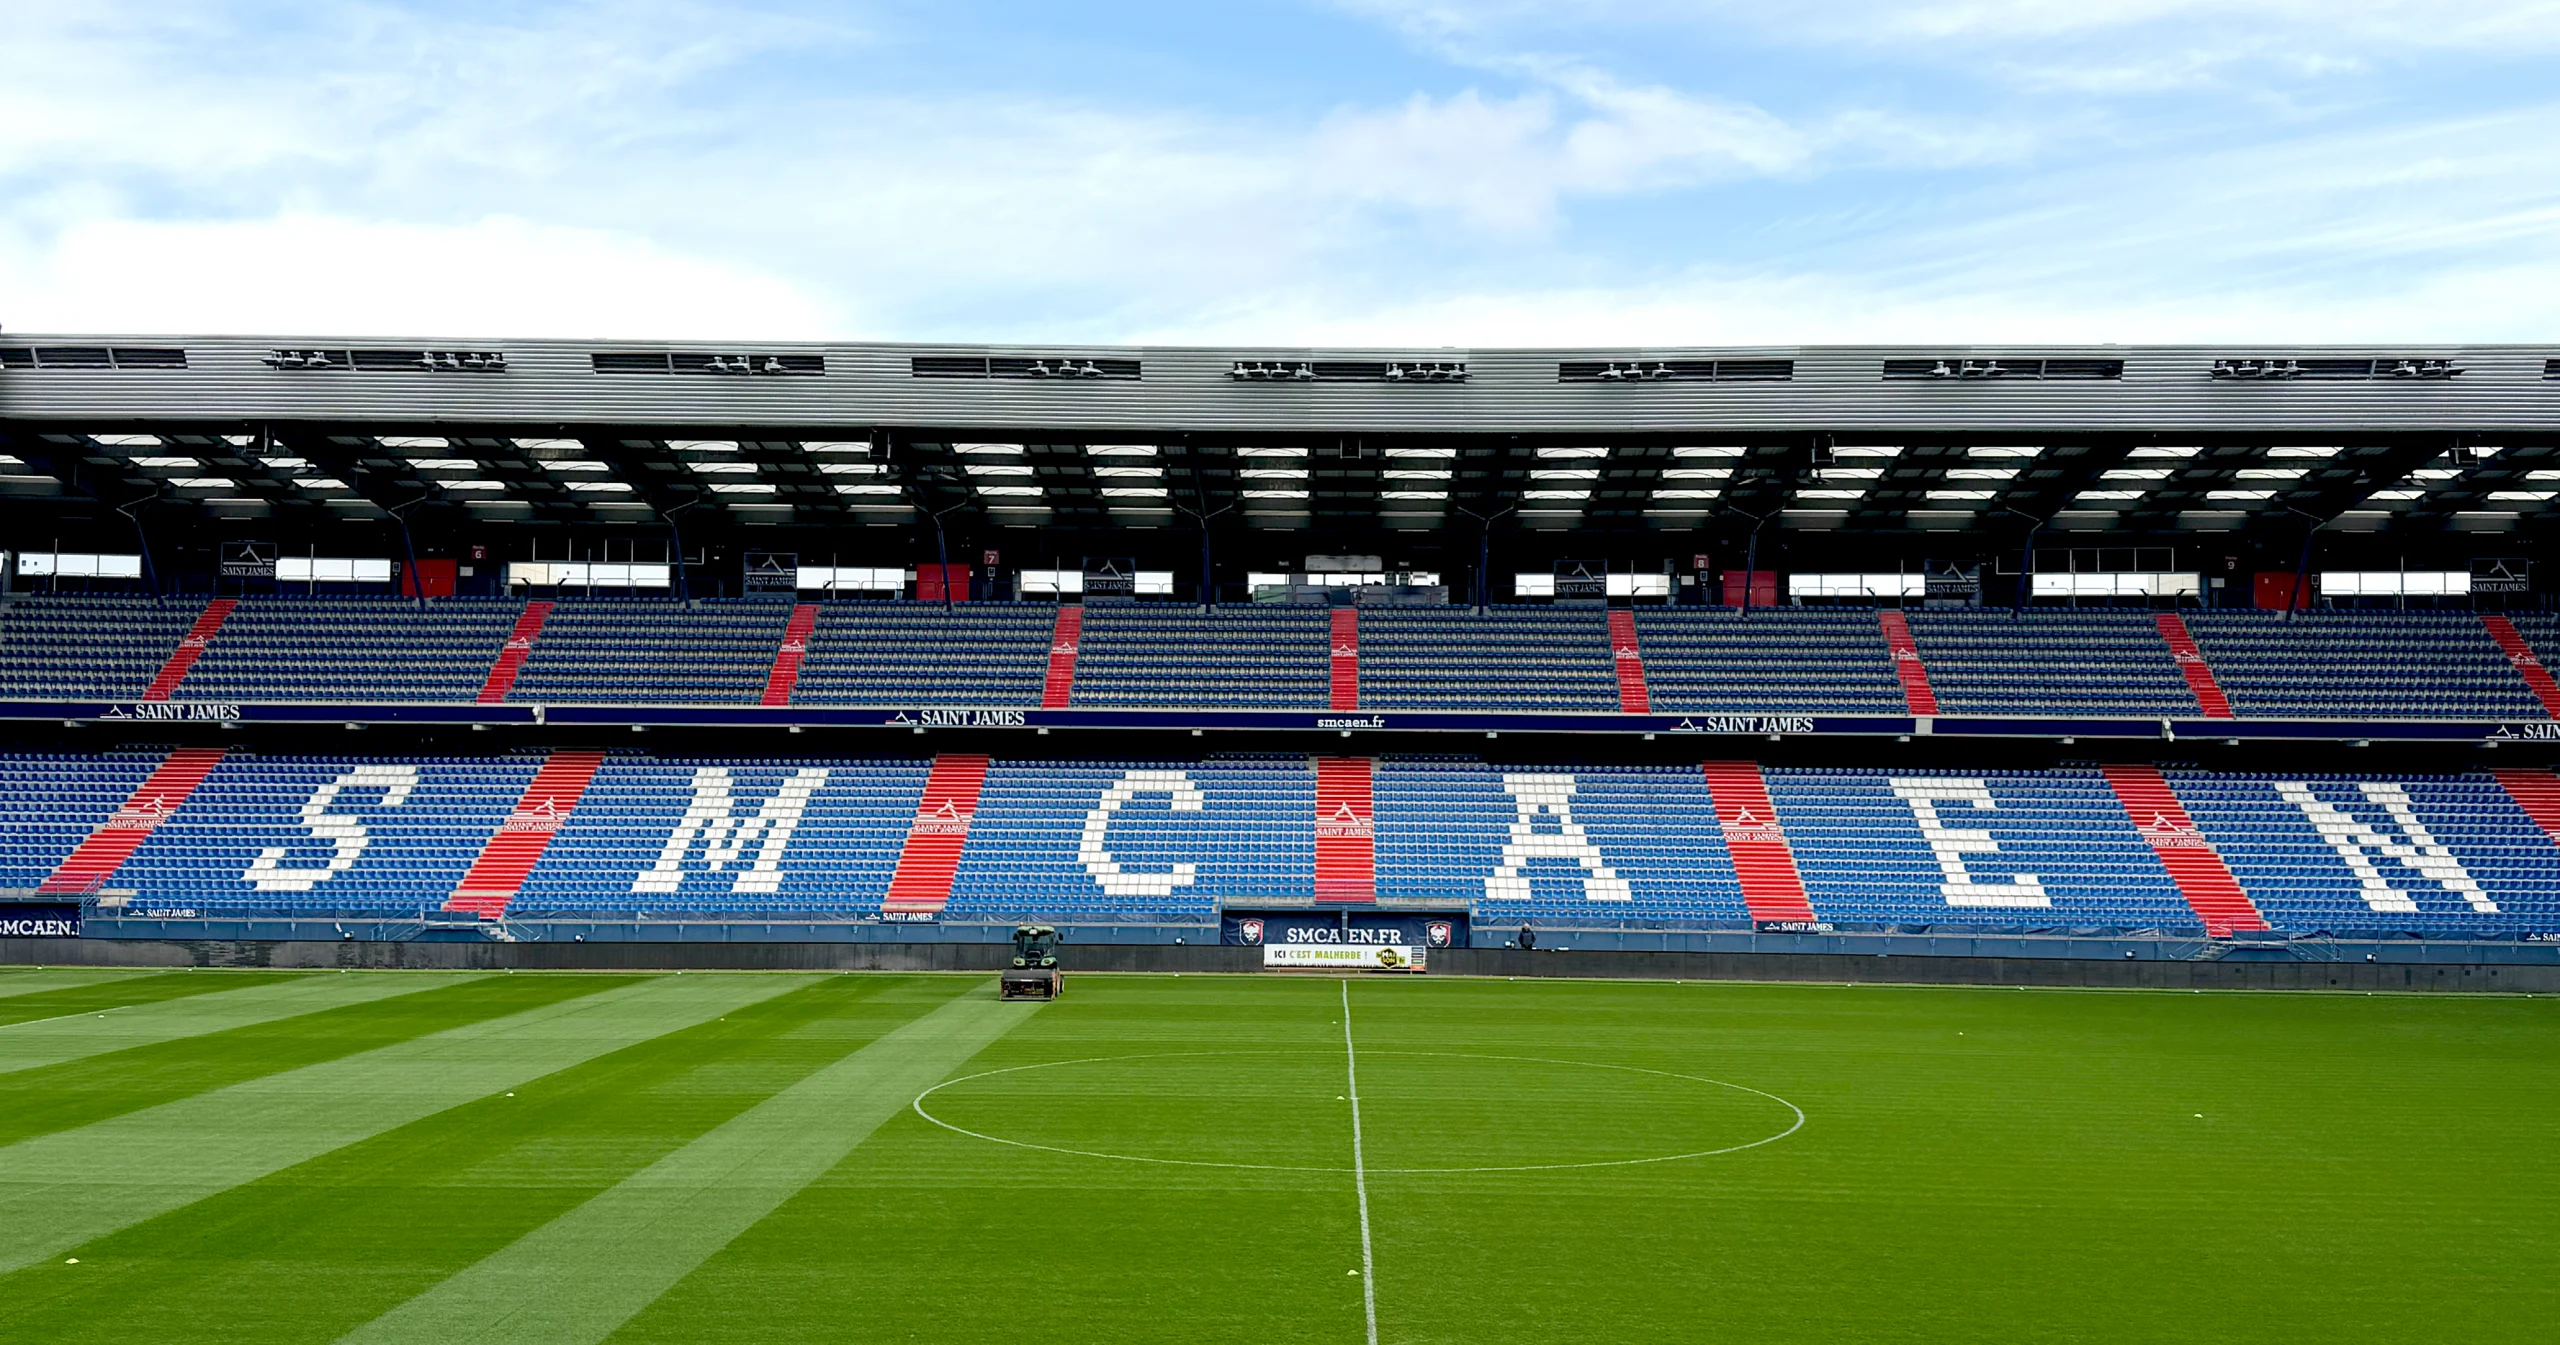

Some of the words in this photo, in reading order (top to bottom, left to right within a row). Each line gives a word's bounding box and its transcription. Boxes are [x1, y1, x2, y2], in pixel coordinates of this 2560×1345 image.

[475, 550, 482, 559] 6
[988, 555, 995, 564] 7
[1698, 559, 1705, 568] 8
[2228, 561, 2235, 570] 9
[223, 567, 249, 576] SAINT
[248, 567, 274, 576] JAMES
[745, 576, 770, 585] SAINT
[1108, 581, 1133, 590] JAMES
[1556, 584, 1581, 592] SAINT
[1926, 584, 1953, 593] SAINT
[1953, 584, 1979, 592] JAMES
[2472, 583, 2499, 592] SAINT
[2499, 583, 2526, 591] JAMES
[135, 704, 184, 719] SAINT
[187, 704, 240, 719] JAMES
[921, 710, 970, 726] SAINT
[972, 711, 1025, 726] JAMES
[1317, 715, 1385, 728] smcaen.fr
[1707, 717, 1757, 732] SAINT
[1759, 717, 1814, 732] JAMES
[1316, 827, 1343, 836] SAINT
[1343, 827, 1372, 836] JAMES
[147, 908, 171, 918] SAINT
[171, 908, 195, 918] JAMES
[883, 912, 908, 921] SAINT
[908, 912, 933, 921] JAMES
[0, 920, 80, 936] MCAEN.
[1781, 922, 1807, 931] SAINT
[1807, 922, 1834, 931] JAMES
[1274, 950, 1286, 959] ICI
[1289, 950, 1311, 959] C'EST
[1314, 950, 1362, 960] MALHERBE
